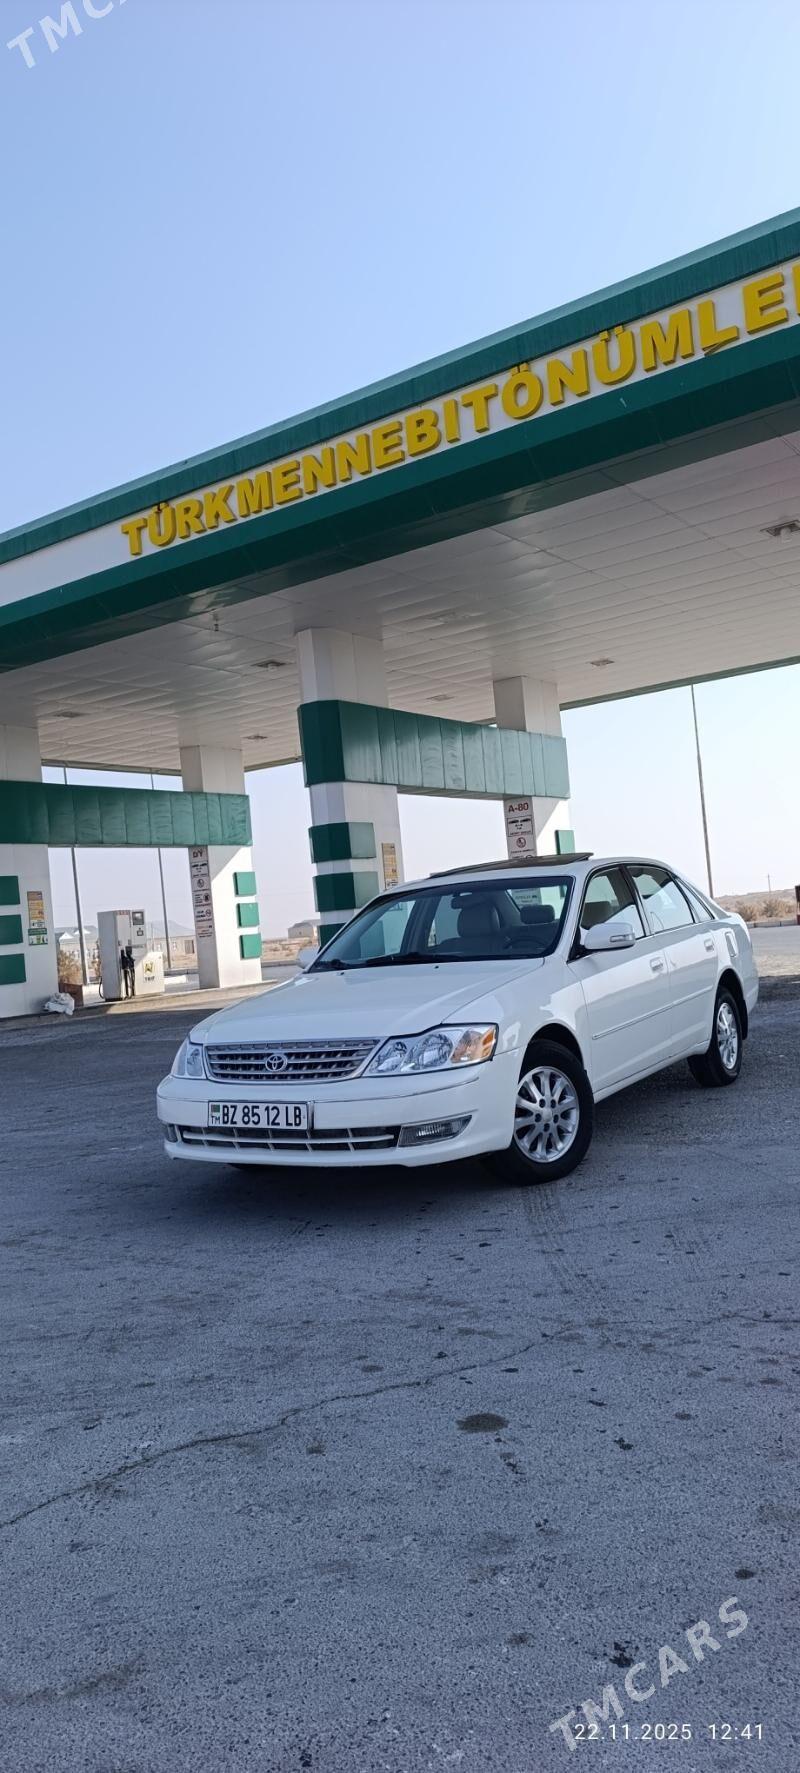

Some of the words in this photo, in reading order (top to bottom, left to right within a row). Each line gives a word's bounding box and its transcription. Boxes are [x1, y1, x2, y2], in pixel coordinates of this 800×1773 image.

[508, 802, 529, 812] A-80
[211, 1116, 220, 1124] TM
[222, 1104, 237, 1125] BZ
[242, 1105, 260, 1125] 85
[264, 1106, 280, 1126] 12
[285, 1106, 302, 1127] LB
